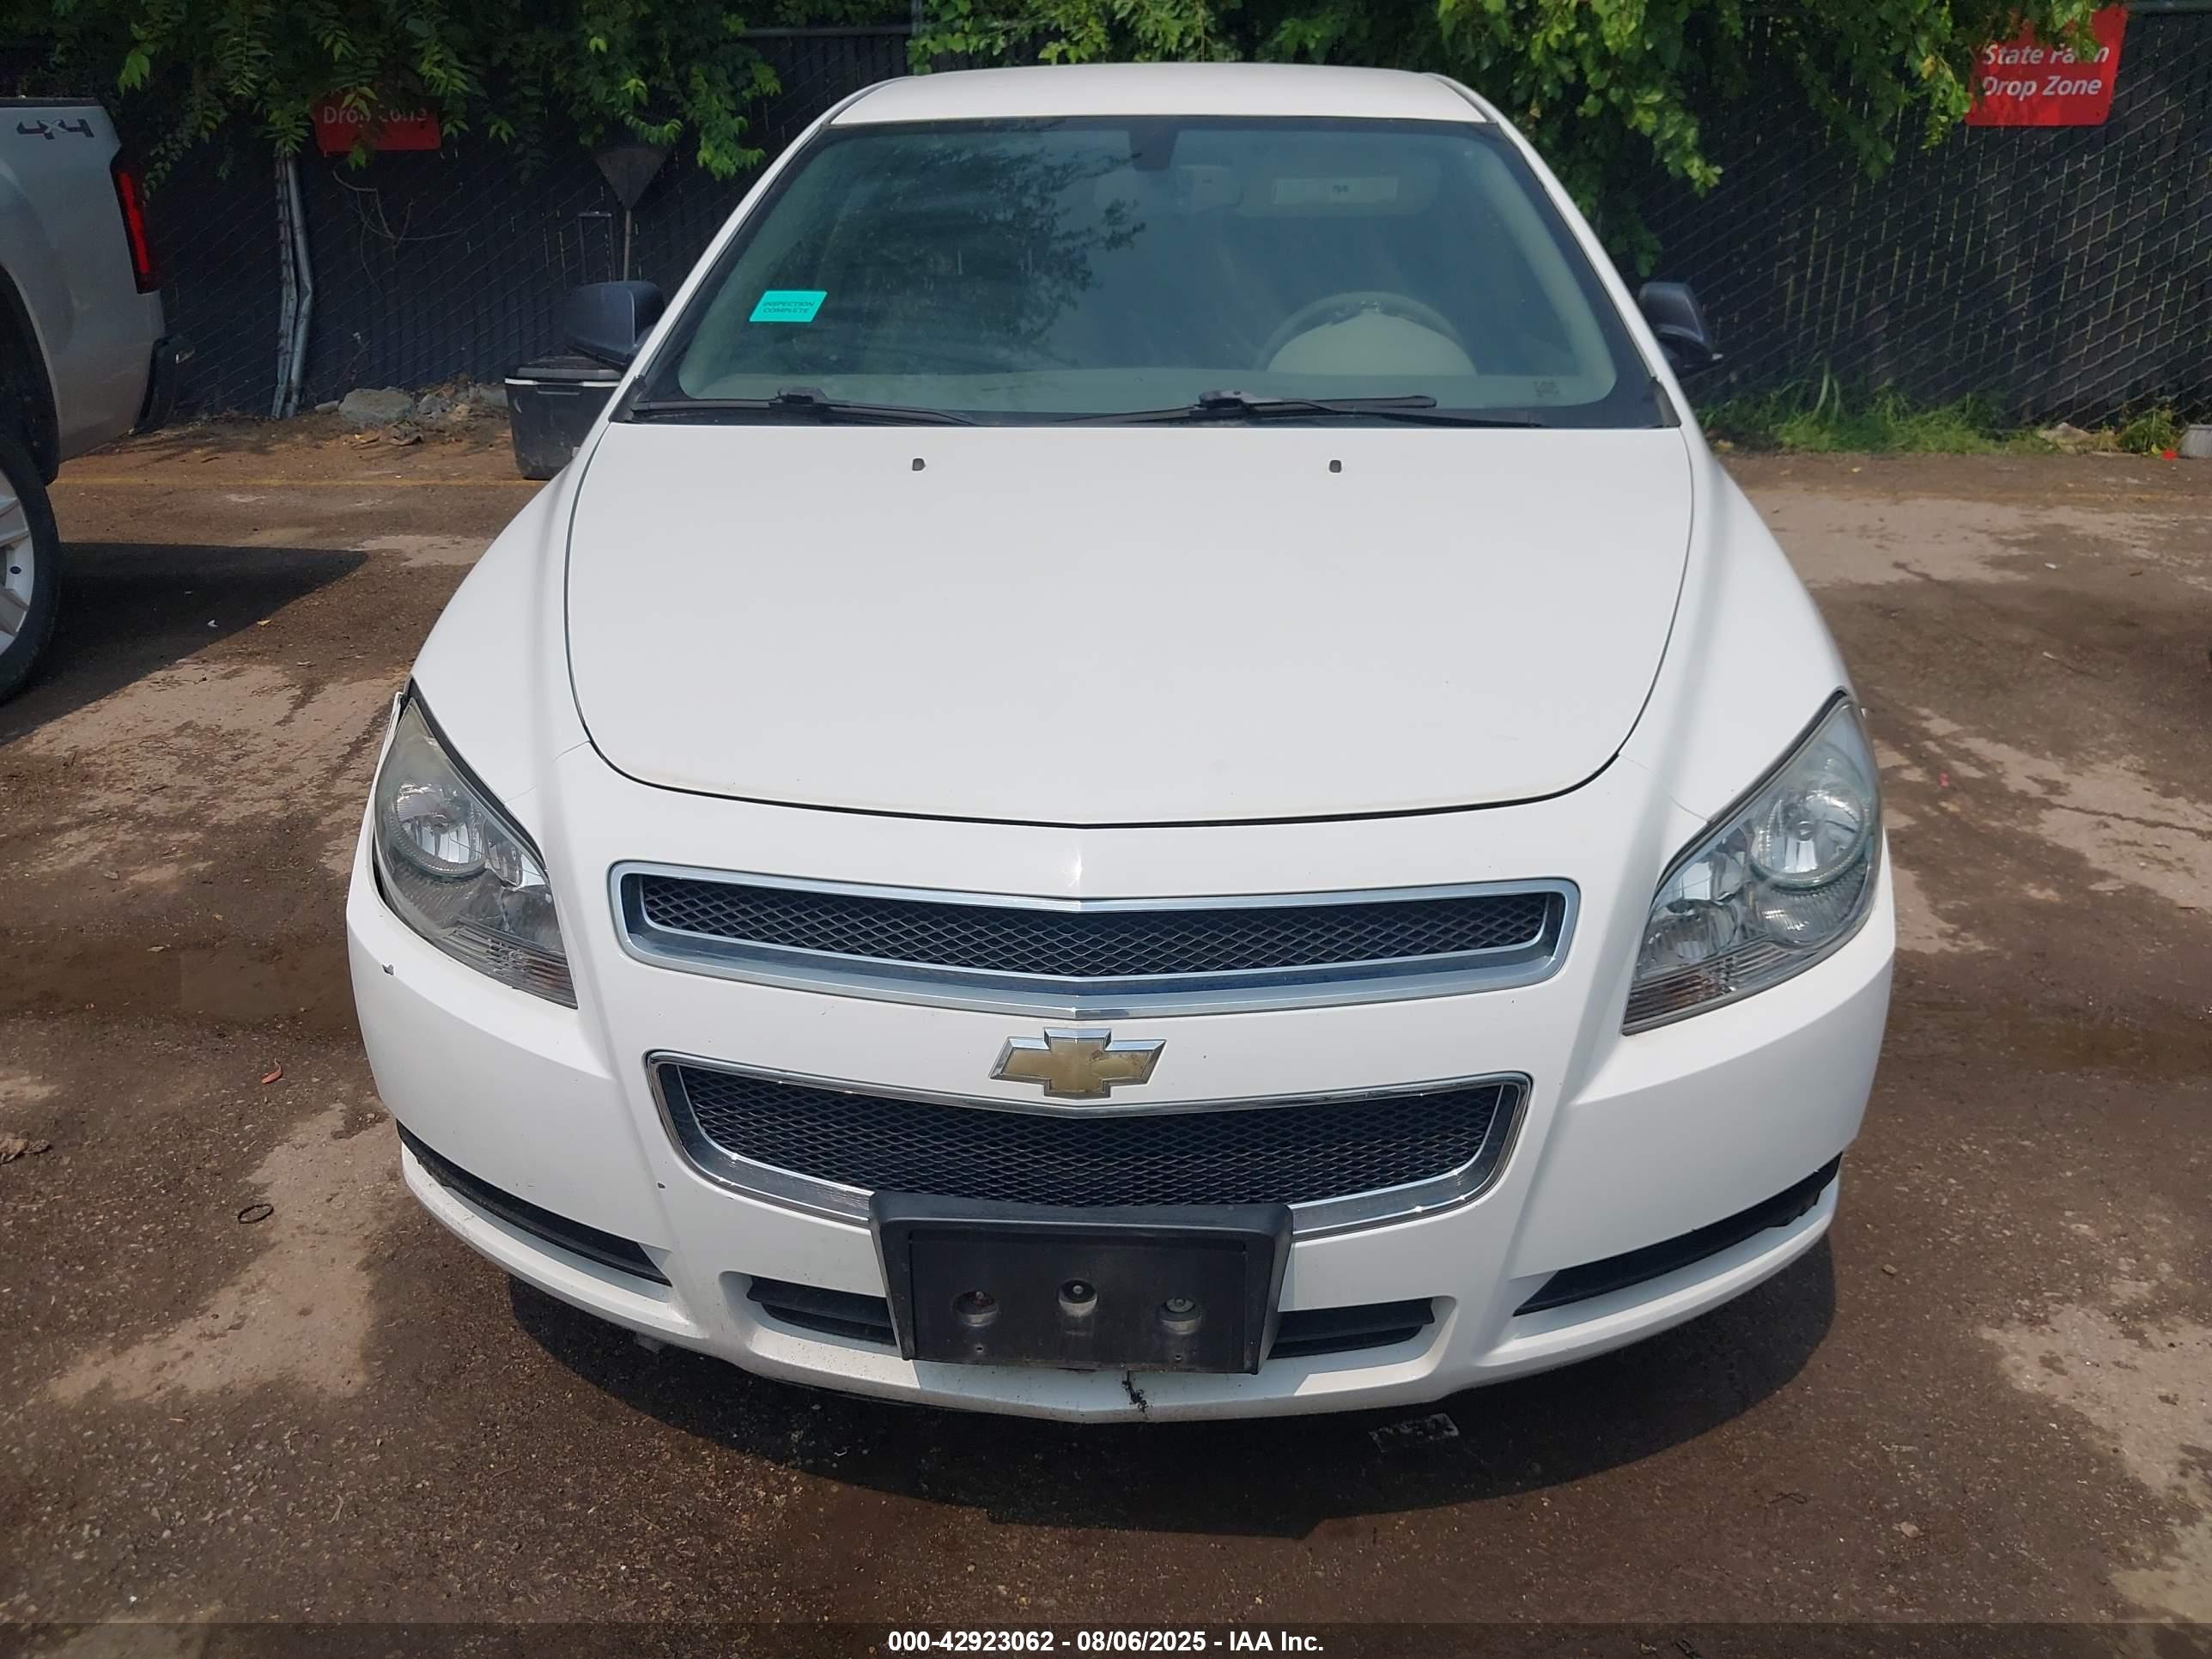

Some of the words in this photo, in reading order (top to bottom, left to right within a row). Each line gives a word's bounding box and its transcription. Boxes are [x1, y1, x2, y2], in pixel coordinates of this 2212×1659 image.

[1982, 44, 2044, 65] State
[2049, 43, 2109, 65] Fam
[1982, 76, 2038, 100] Drop
[2042, 76, 2103, 95] Zone
